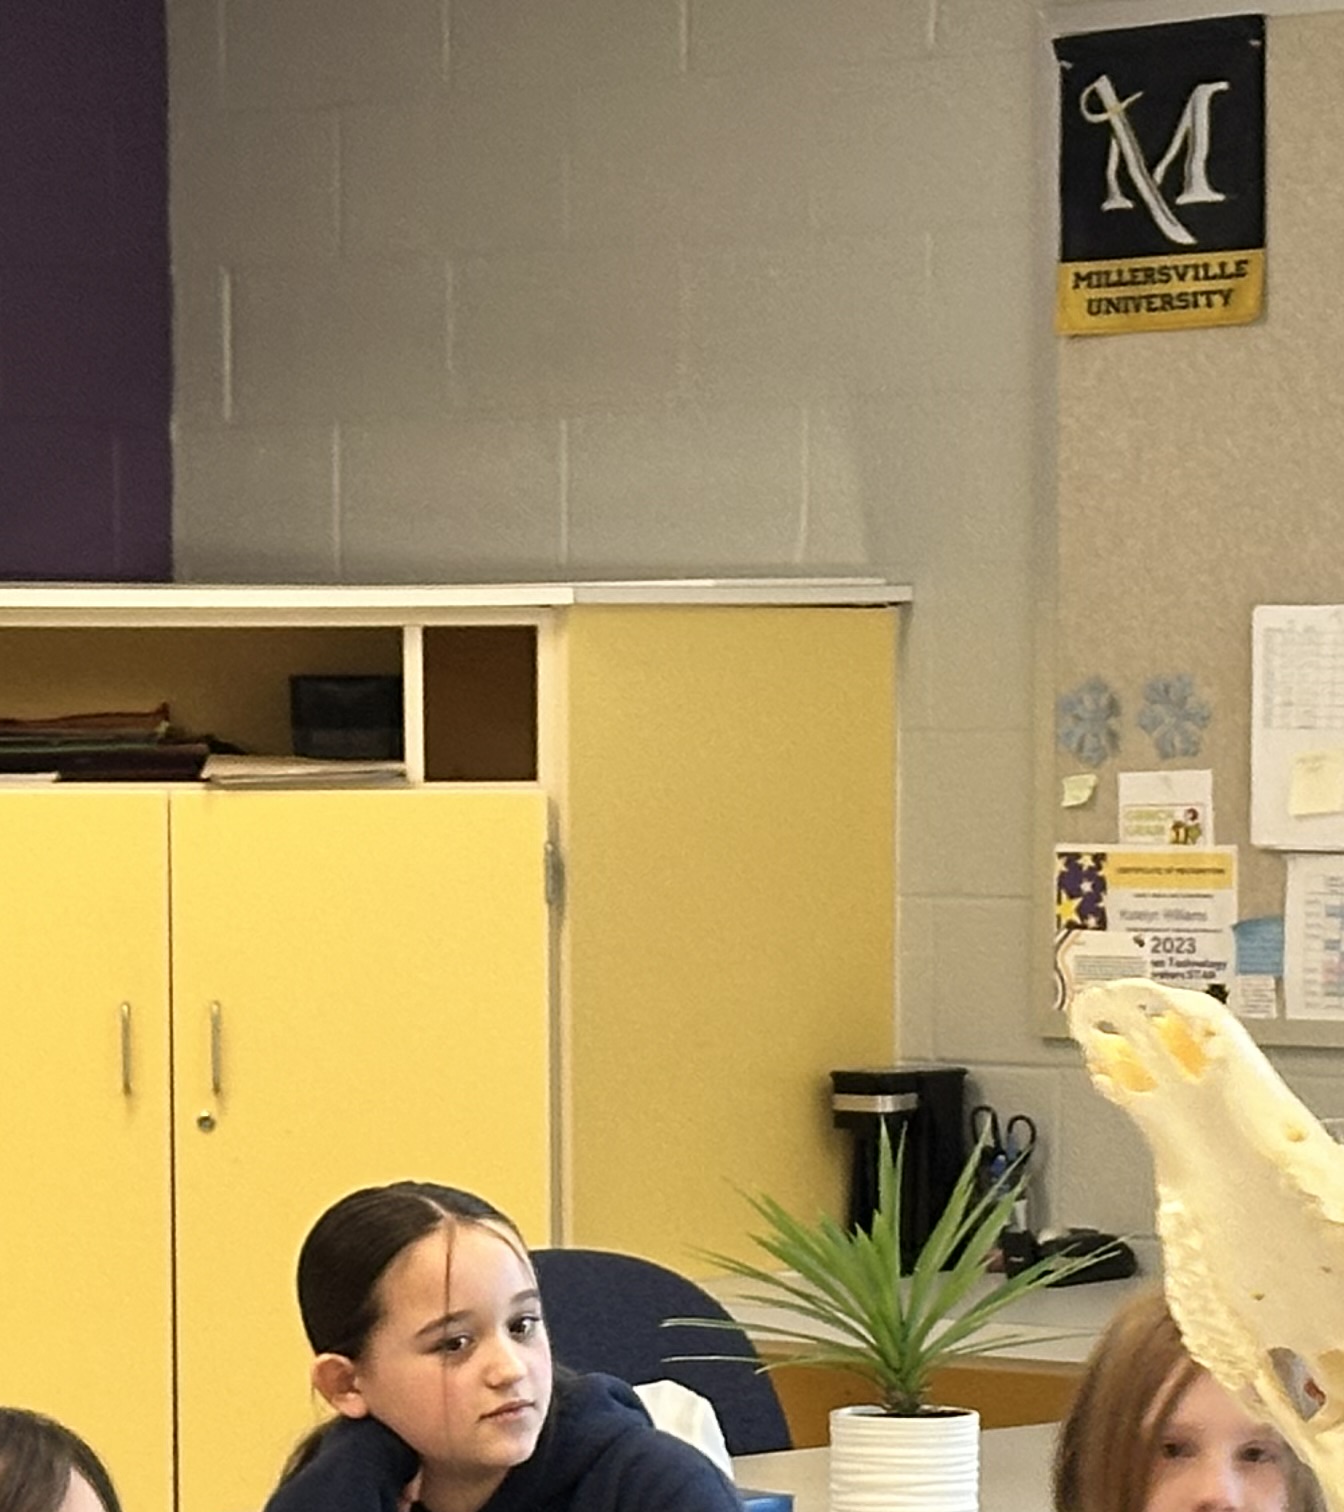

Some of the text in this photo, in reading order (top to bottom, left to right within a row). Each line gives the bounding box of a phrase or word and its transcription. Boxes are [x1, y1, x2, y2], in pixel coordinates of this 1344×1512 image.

[1080, 74, 1229, 244] M
[1072, 260, 1249, 290] MILLERSVILLE
[1086, 288, 1234, 317] UNIVERSITY
[1151, 935, 1197, 954] 2023
